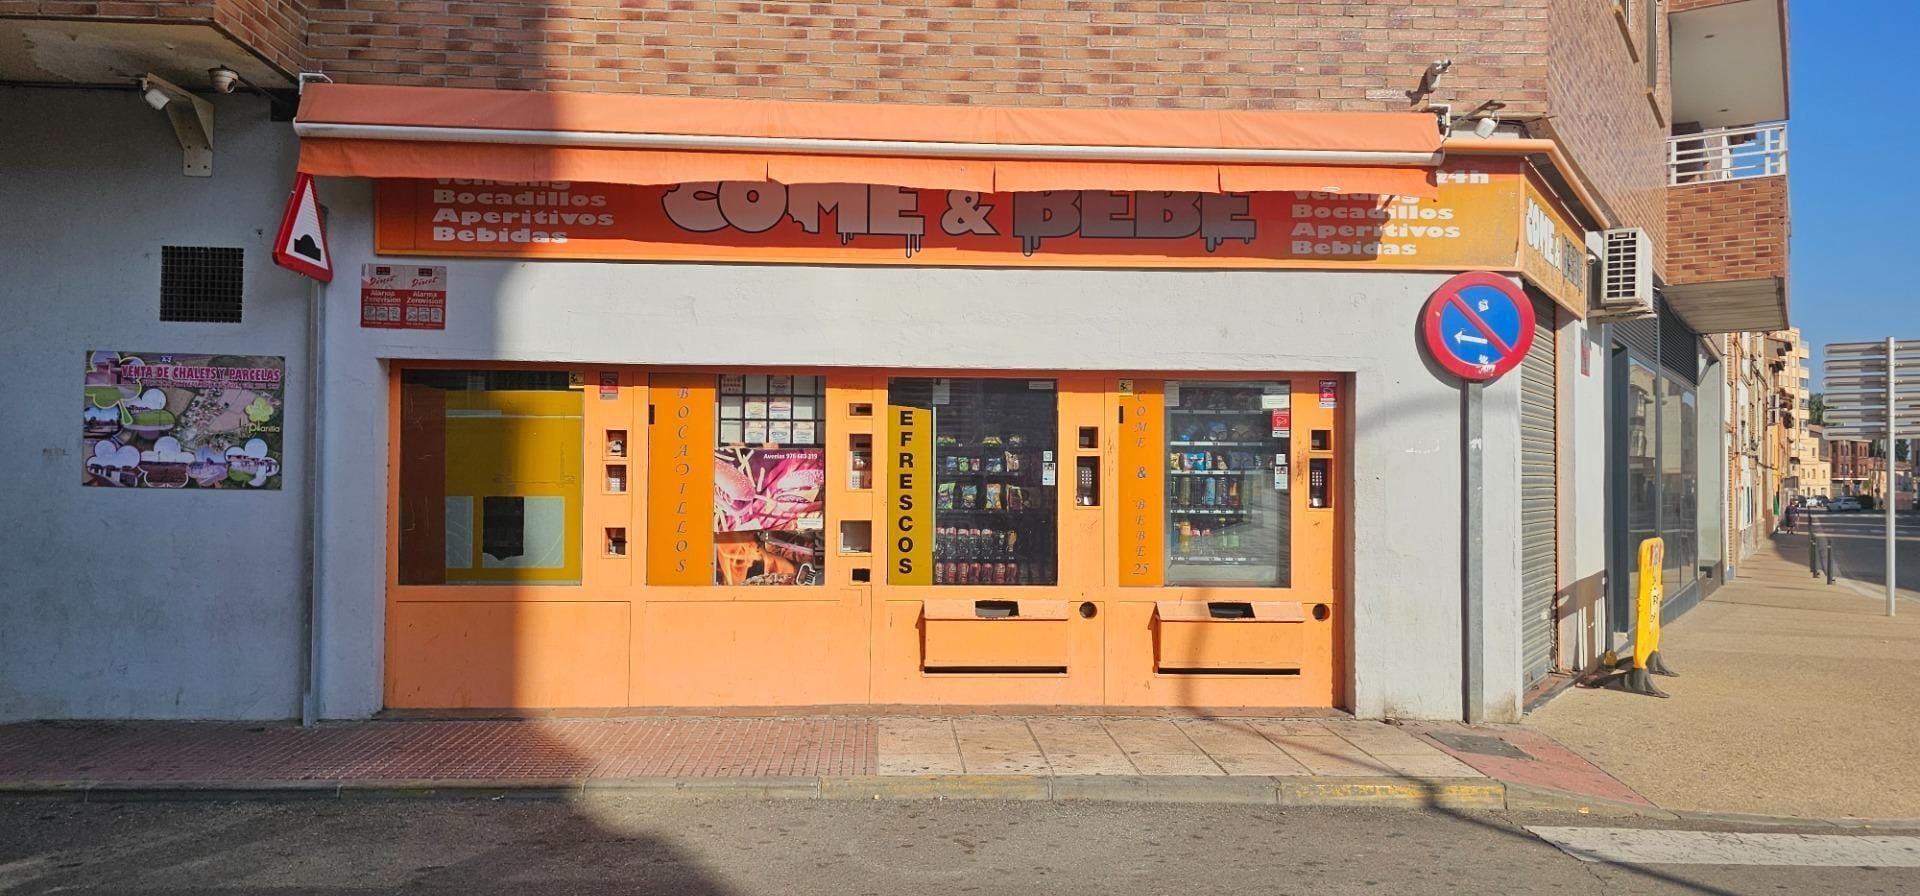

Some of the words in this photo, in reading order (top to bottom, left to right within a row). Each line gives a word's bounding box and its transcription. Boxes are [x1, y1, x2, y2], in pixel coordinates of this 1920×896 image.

[434, 189, 607, 206] Bocadillos
[432, 208, 615, 226] Aperitivos
[661, 182, 926, 258] COME
[940, 190, 1001, 236] &
[1012, 190, 1256, 256] BEBE
[1291, 204, 1454, 219] Bocadillos
[433, 226, 568, 243] Bebidas
[1291, 222, 1462, 239] Aperitivos
[1291, 240, 1418, 256] Bebidas
[121, 365, 152, 378] VENTA
[156, 366, 169, 378] DE
[173, 366, 216, 380] CHALETS
[229, 368, 281, 382] PARCELAS
[674, 386, 691, 574] BOCADILLOS
[1137, 466, 1146, 478] &
[897, 410, 914, 575] EFRESCOS
